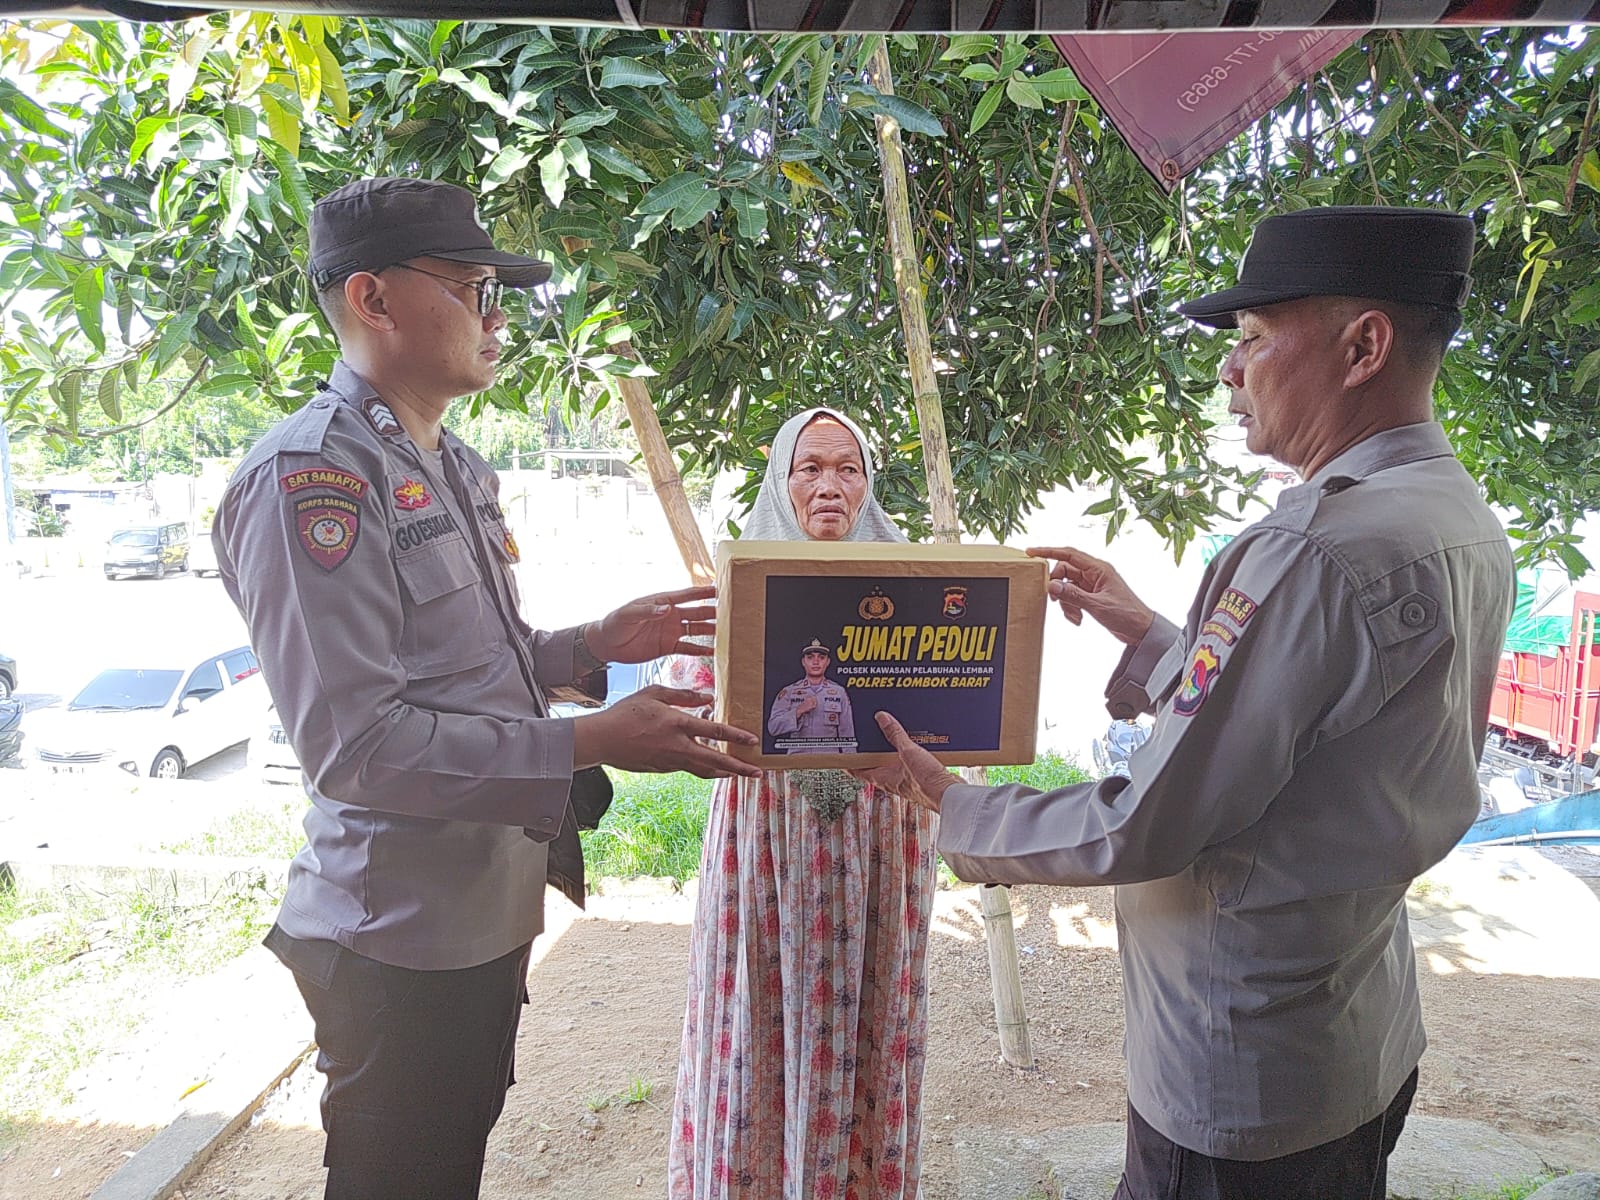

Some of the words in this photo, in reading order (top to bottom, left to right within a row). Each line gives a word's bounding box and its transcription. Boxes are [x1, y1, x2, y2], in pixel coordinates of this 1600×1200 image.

[288, 473, 309, 487] SAT
[312, 472, 362, 493] SAMAPTA
[298, 498, 323, 511] KORPS
[836, 625, 917, 661] JUMAT
[916, 625, 997, 661] PEDULI
[847, 677, 895, 688] POLRES
[896, 677, 949, 688] LOMBOK
[950, 677, 990, 688] BARAT
